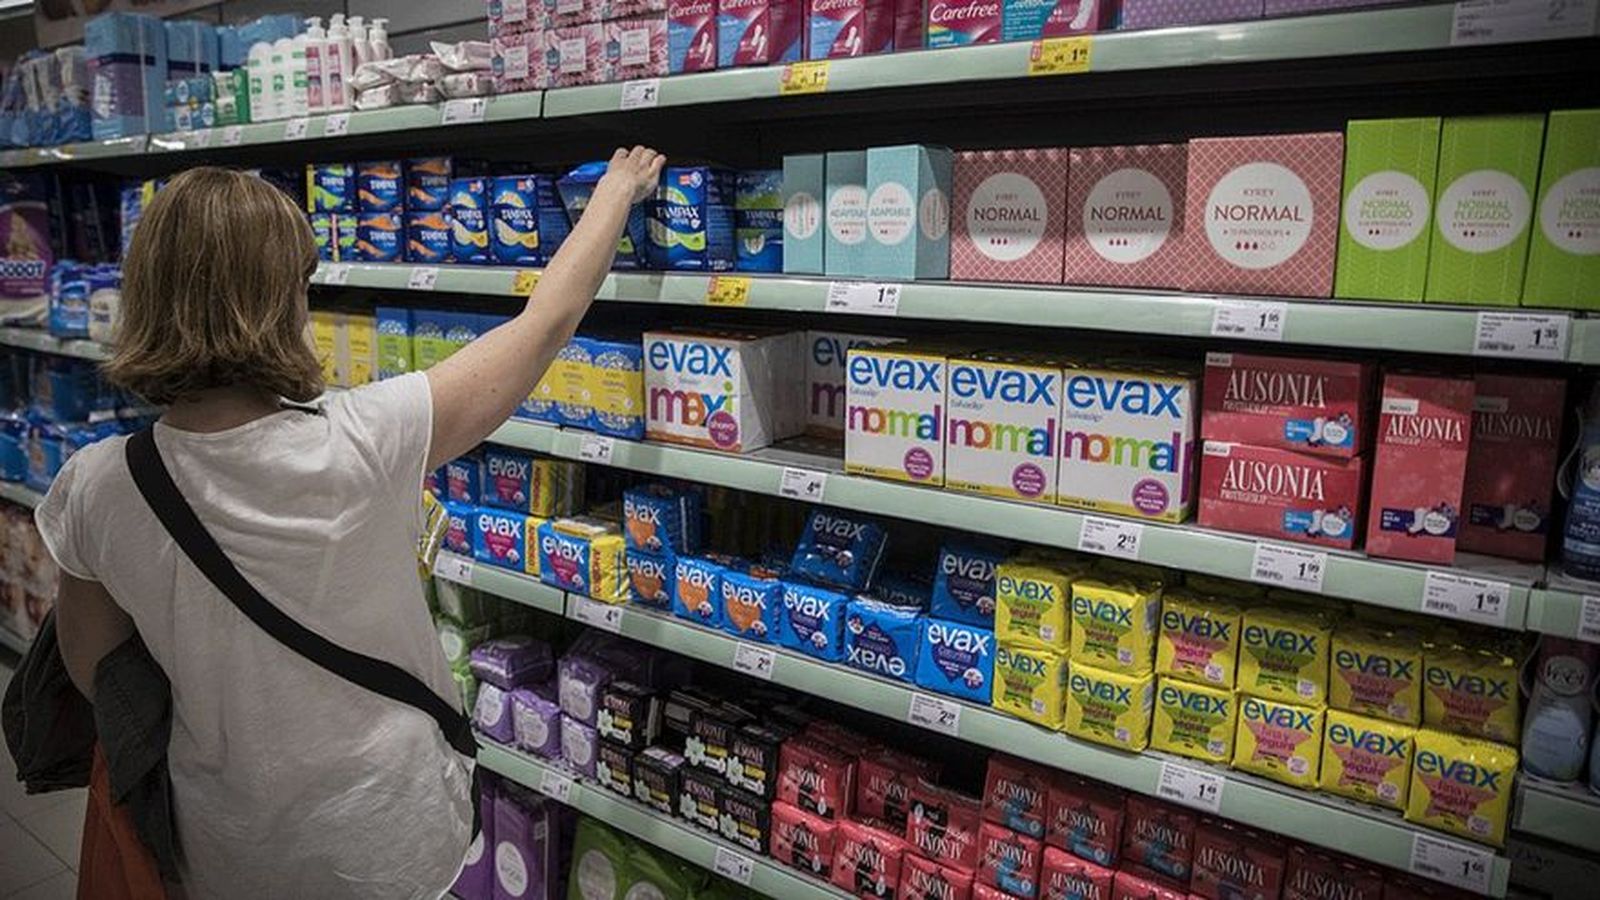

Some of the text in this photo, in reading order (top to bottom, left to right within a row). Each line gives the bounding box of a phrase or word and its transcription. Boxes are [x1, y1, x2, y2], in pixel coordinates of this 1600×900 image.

[930, 3, 999, 22] Carefree
[656, 206, 700, 219] TAMPAX
[974, 207, 1041, 221] NORMAL
[1091, 205, 1166, 220] NORMAL
[1214, 204, 1305, 221] NORMAL
[650, 341, 732, 377] evax
[850, 356, 941, 393] evax
[951, 366, 1055, 407] evax
[1067, 375, 1182, 418] evax
[1224, 369, 1328, 409] AUSONIA
[651, 381, 734, 426] maxi
[1386, 414, 1463, 442] AUSONIA
[1478, 413, 1552, 440] AUSONIA
[488, 457, 528, 480] evax
[1221, 459, 1325, 500] AUSONIA
[478, 514, 521, 539] evax
[624, 500, 661, 526] evax
[812, 513, 867, 542] evax
[543, 535, 585, 564] evax
[627, 557, 667, 581] evax
[675, 561, 715, 591] evax
[942, 554, 998, 582] evax
[722, 580, 767, 610] evax
[784, 589, 830, 621] evax
[999, 576, 1055, 603] evax
[1073, 596, 1132, 627] evax
[1163, 610, 1232, 642] evax
[928, 623, 989, 657] evax
[1244, 625, 1318, 655] evax
[847, 644, 906, 676] evax
[997, 648, 1046, 677] evax
[1335, 650, 1414, 681] evax
[1071, 674, 1131, 705] evax
[1426, 665, 1510, 700] evax
[1160, 686, 1227, 717] evax
[1244, 699, 1314, 732] evax
[1329, 724, 1407, 759] evax
[1416, 751, 1500, 791] evax
[994, 779, 1043, 808] AUSONIA
[1057, 807, 1107, 836] AUSONIA
[1135, 818, 1188, 850] AUSONIA
[987, 837, 1033, 868] AUSONIA
[1197, 847, 1265, 887] AUSONIA
